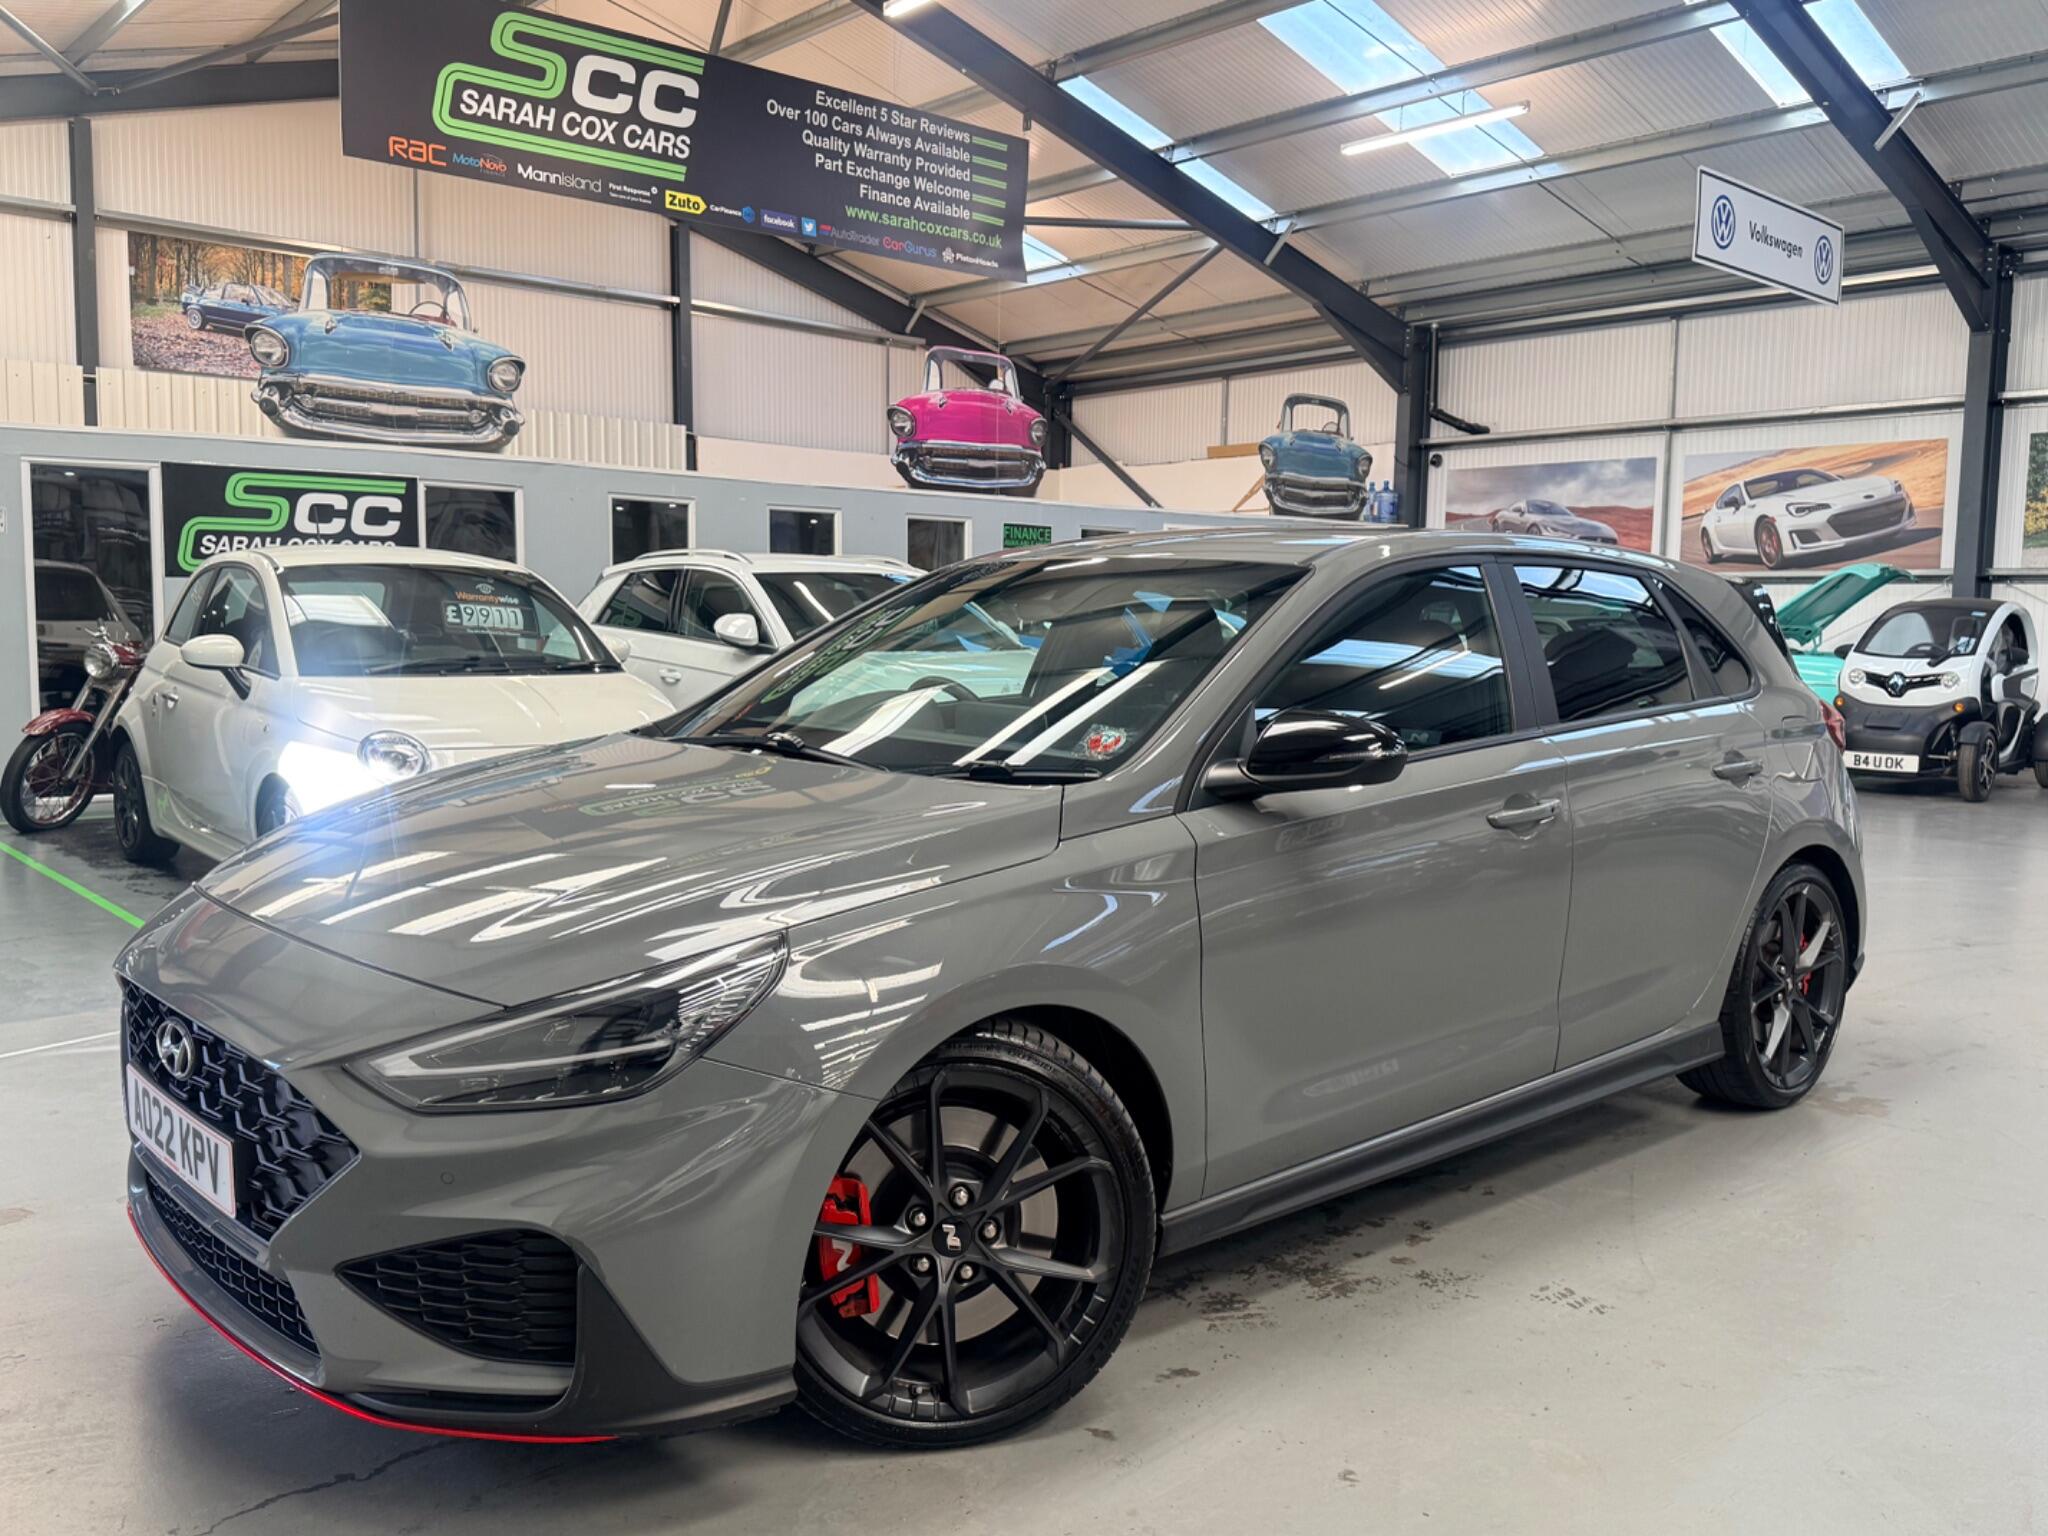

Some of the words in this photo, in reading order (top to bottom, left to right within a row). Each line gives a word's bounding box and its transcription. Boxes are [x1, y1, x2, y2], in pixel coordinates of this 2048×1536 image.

[459, 88, 556, 132] SARAH
[561, 111, 618, 145] COX
[623, 125, 691, 160] CARS
[766, 98, 801, 121] Over
[804, 109, 828, 128] 100
[831, 116, 863, 137] Cars
[865, 126, 912, 150] Always
[914, 138, 971, 163] Available
[816, 89, 877, 120] Excellent
[879, 107, 888, 122] 5
[891, 111, 918, 130] Star
[920, 118, 971, 143] Reviews
[452, 152, 508, 173] MotoNovo
[802, 129, 851, 157] Quality
[853, 142, 912, 172] Warranty
[915, 157, 971, 182] Provided
[815, 153, 843, 173] Part
[846, 162, 910, 190] Exchange
[913, 176, 971, 201] Welcome
[668, 193, 701, 211] Zuto
[764, 214, 796, 229] facebook
[860, 183, 911, 208] Finance
[913, 196, 971, 220] Available
[845, 204, 1003, 249] www.sarahcoxcars.co.uk
[882, 236, 937, 258] CarGurus
[1749, 220, 1804, 259] Volkswagen
[1004, 526, 1051, 542] FINANCE
[178, 1116, 219, 1196] KPV
